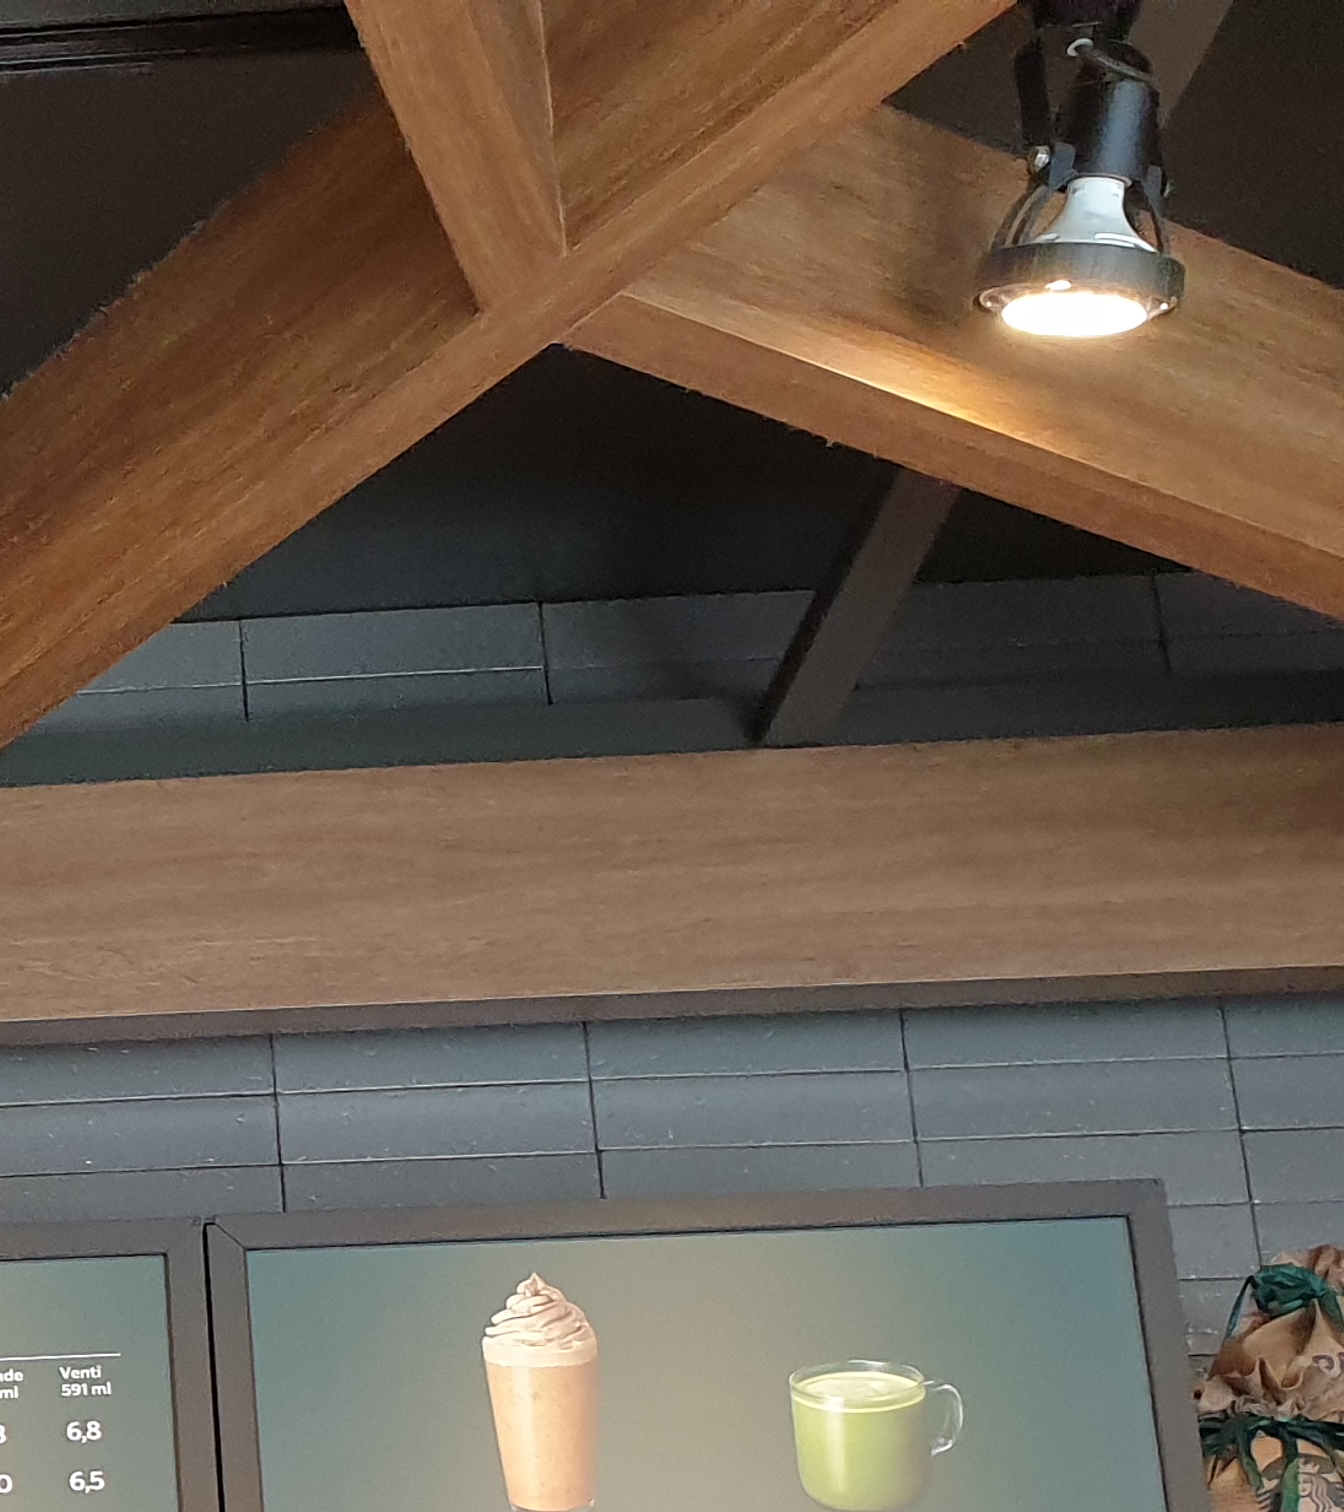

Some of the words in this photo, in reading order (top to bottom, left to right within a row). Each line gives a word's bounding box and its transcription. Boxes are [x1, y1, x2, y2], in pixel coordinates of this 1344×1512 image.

[59, 1366, 101, 1379] Venti
[61, 1383, 88, 1397] 591
[91, 1381, 112, 1396] ml
[69, 1470, 105, 1494] 6,5
